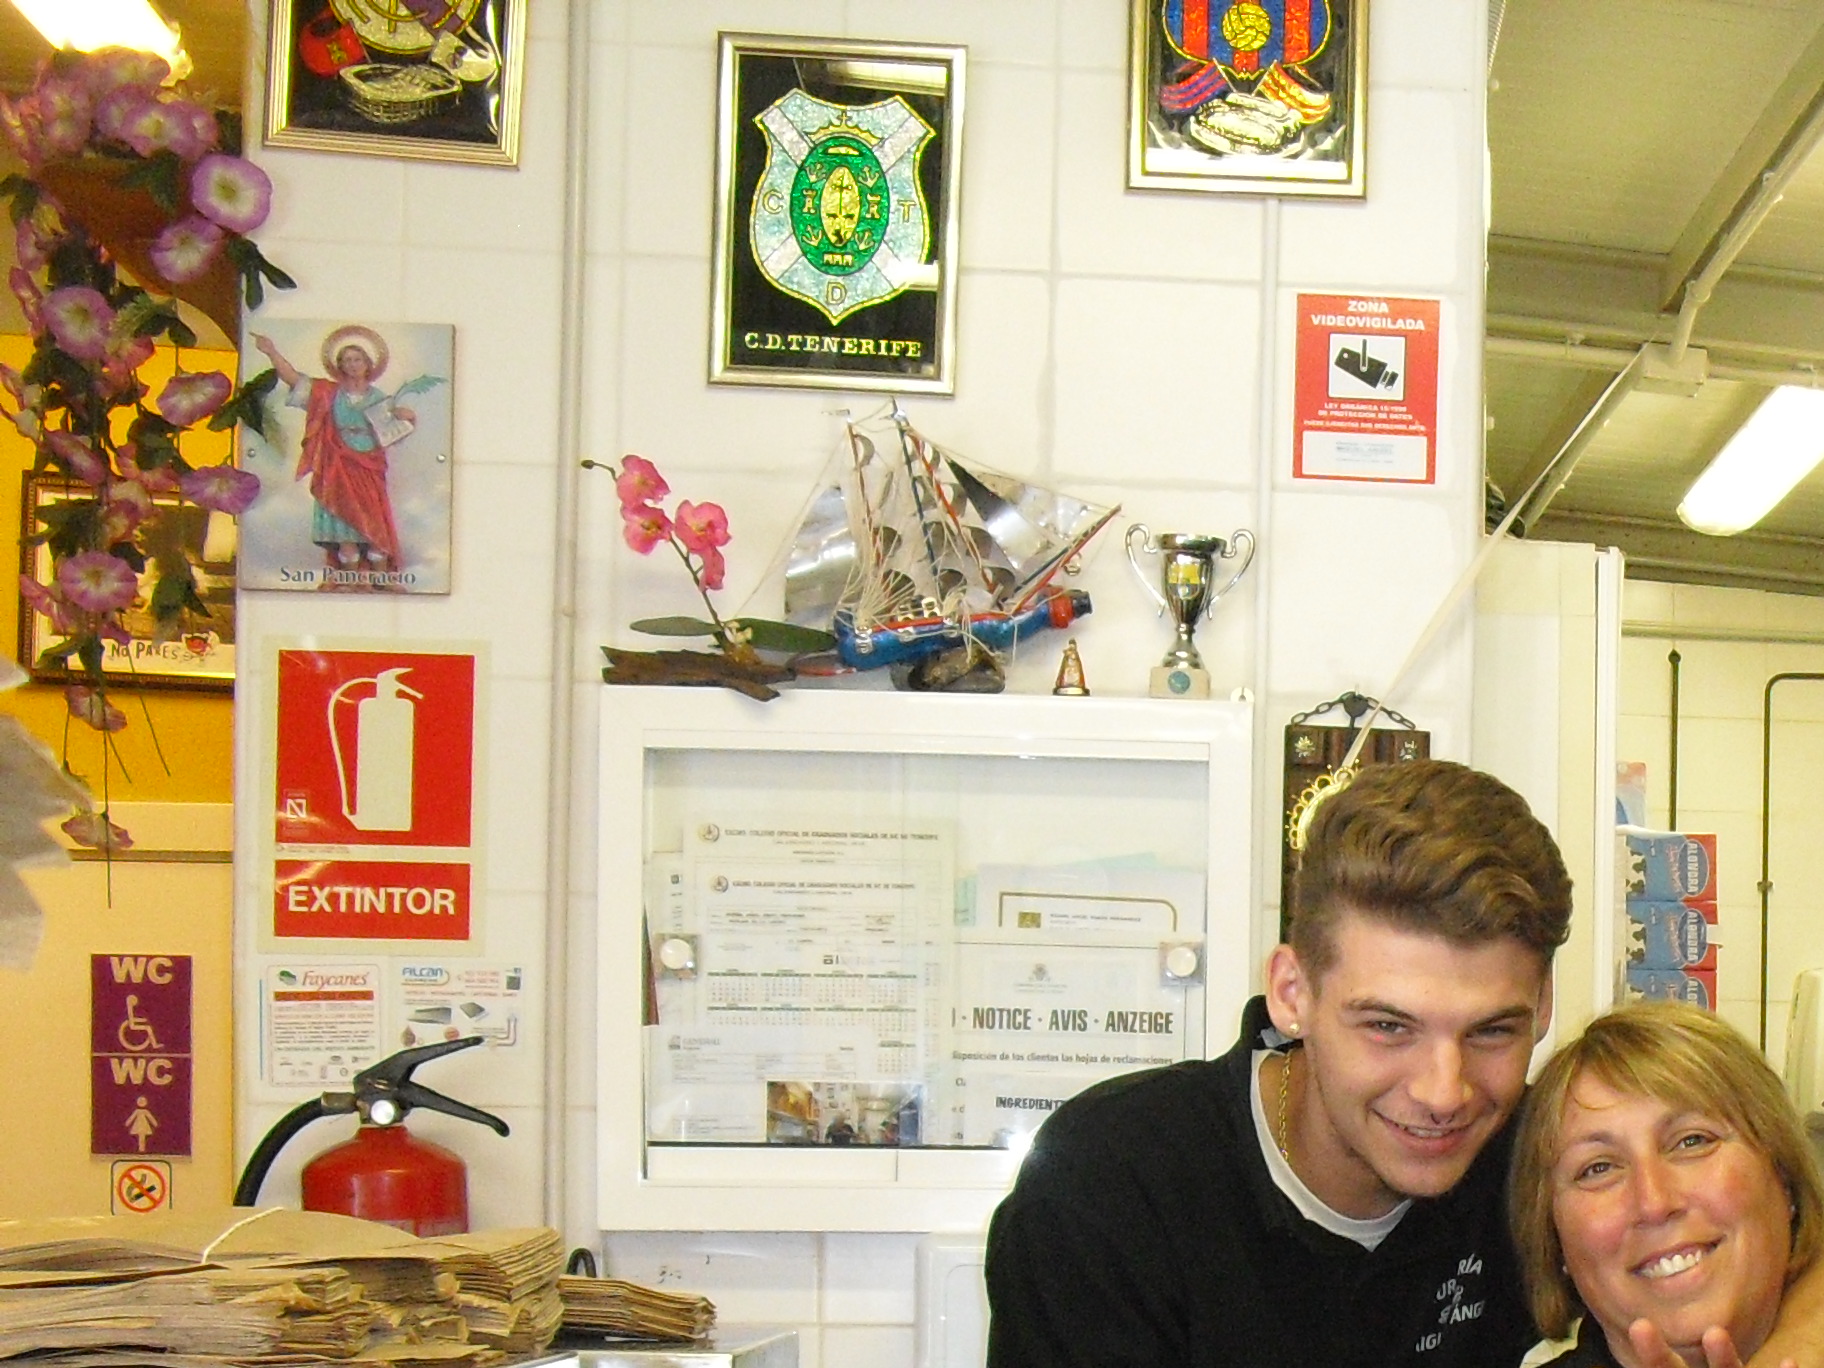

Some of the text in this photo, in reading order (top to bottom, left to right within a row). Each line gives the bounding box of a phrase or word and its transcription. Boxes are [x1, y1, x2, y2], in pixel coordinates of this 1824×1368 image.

[1348, 301, 1389, 313] ZONA
[1311, 314, 1425, 330] VIDEOVIGILADA
[744, 332, 922, 358] C.D.TENERIFE
[280, 566, 417, 585] San Pancracio
[1687, 843, 1698, 893] ALONDRA
[287, 885, 456, 915] EXTINTOR
[1687, 911, 1698, 962] ALONDRA
[110, 956, 173, 984] WC
[972, 1007, 1174, 1034] NOTICE AVIS ANZEIGE
[110, 1058, 173, 1085] WC
[999, 1052, 1010, 1061] de
[1061, 1053, 1074, 1063] las
[1075, 1053, 1098, 1064] hojas
[1100, 1053, 1111, 1063] de
